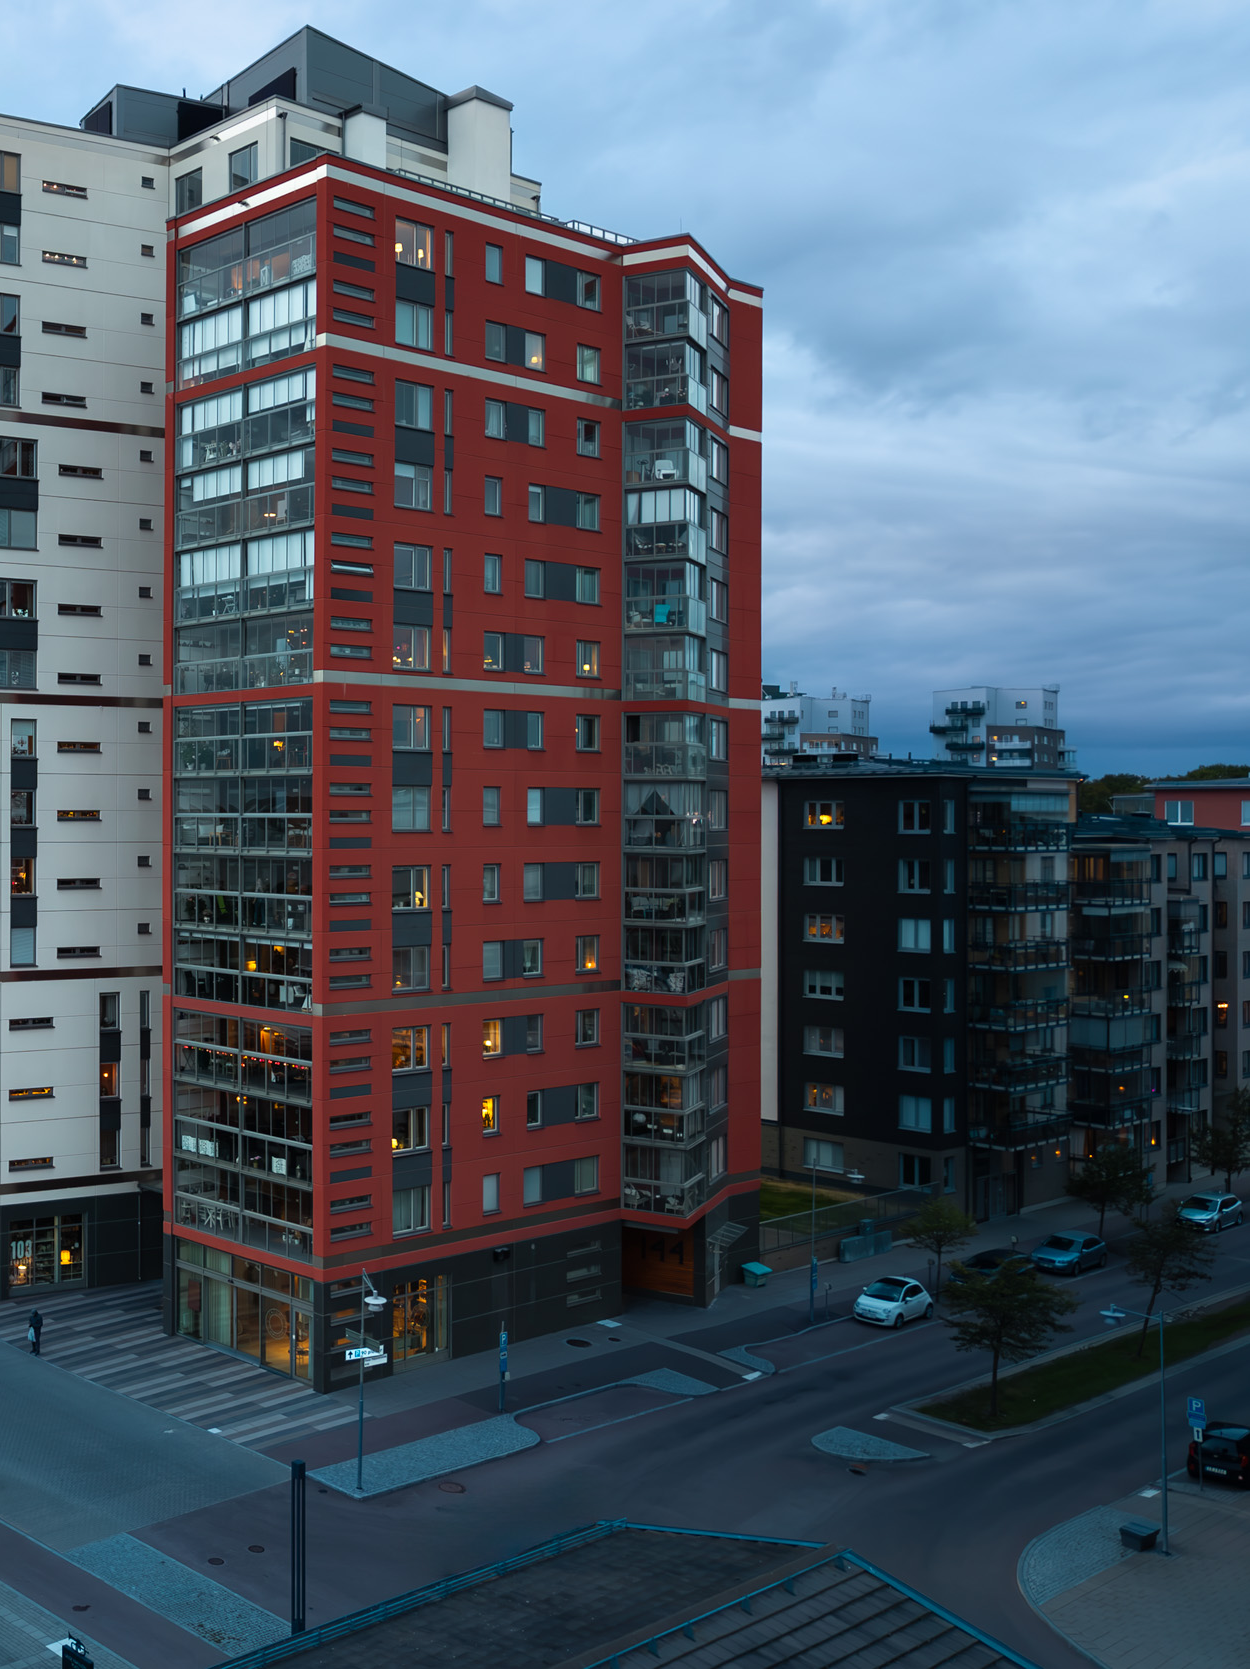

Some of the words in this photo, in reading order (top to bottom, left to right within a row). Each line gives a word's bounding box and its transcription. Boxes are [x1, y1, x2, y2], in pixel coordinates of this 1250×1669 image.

[10, 1239, 32, 1260] 103
[641, 1235, 683, 1265] 144
[501, 1334, 507, 1345] P
[1192, 1400, 1202, 1411] P
